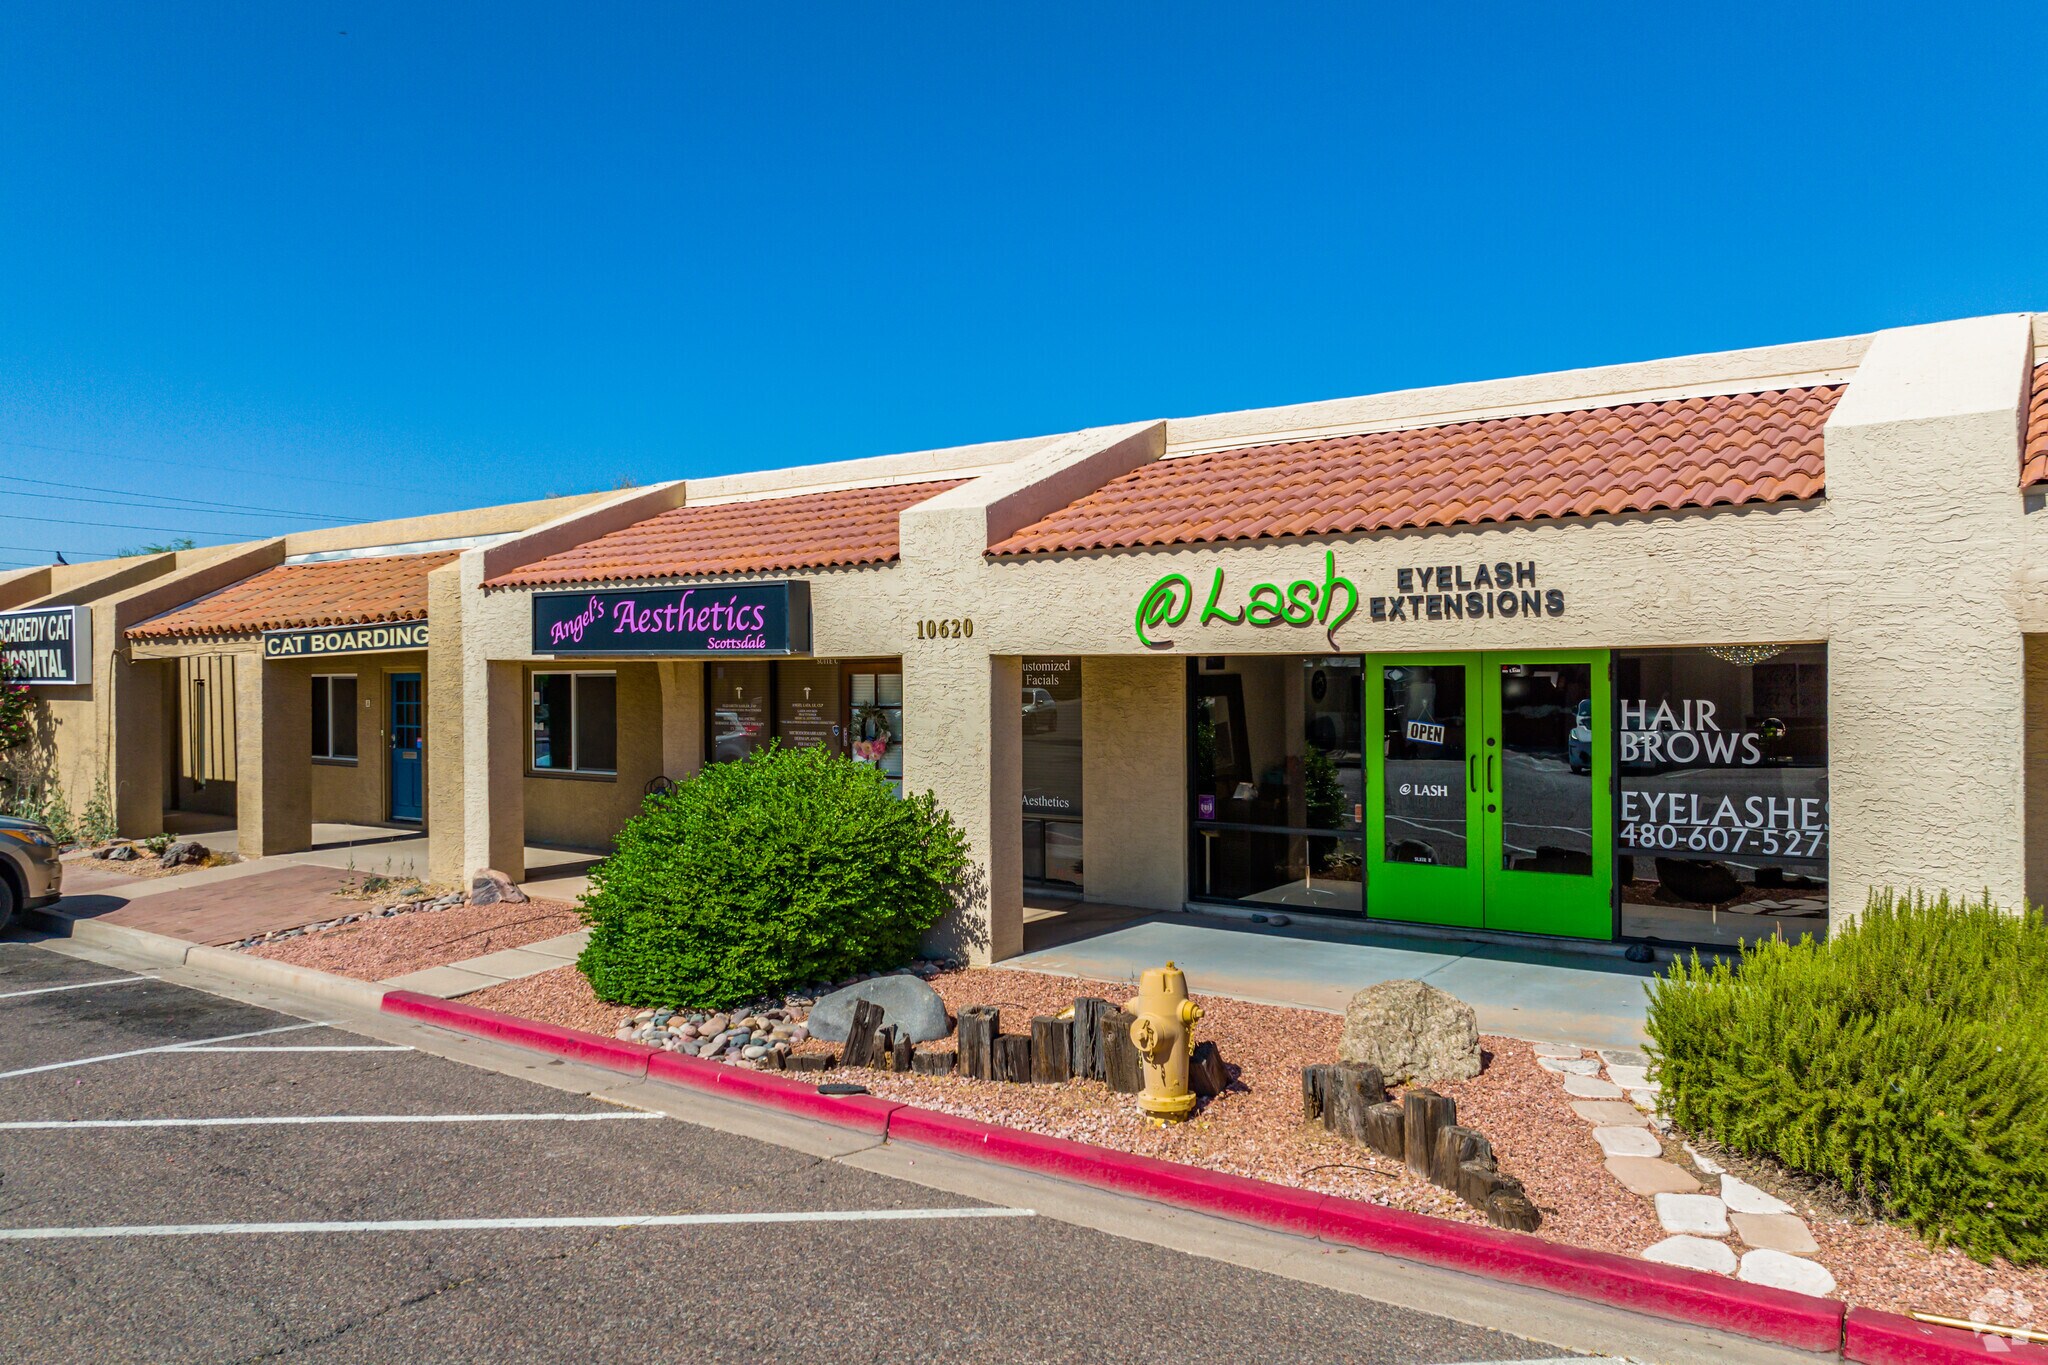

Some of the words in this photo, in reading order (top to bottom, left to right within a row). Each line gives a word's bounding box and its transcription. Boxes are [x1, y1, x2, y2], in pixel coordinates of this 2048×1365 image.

[1396, 560, 1536, 594] EYELASH
[550, 595, 605, 645] Angel's
[612, 590, 766, 634] Aesthetics
[1369, 587, 1566, 623] EXTENSIONS
[47, 614, 72, 641] CAT
[266, 635, 306, 655] CAT
[310, 625, 428, 652] BOARDING
[707, 633, 766, 650] Scottsdale
[916, 618, 974, 640] 10620
[1022, 660, 1071, 672] ustomized
[1025, 673, 1060, 686] Facials
[1620, 699, 1721, 732] HAIR
[1410, 723, 1443, 743] OPEN
[1620, 731, 1761, 765] BROWS
[1022, 794, 1070, 808] Aesthetics
[1399, 783, 1412, 796] @
[1414, 784, 1448, 797] LASH
[1620, 791, 1829, 831] EYELASHE
[1620, 823, 1829, 857] 480-607-527
